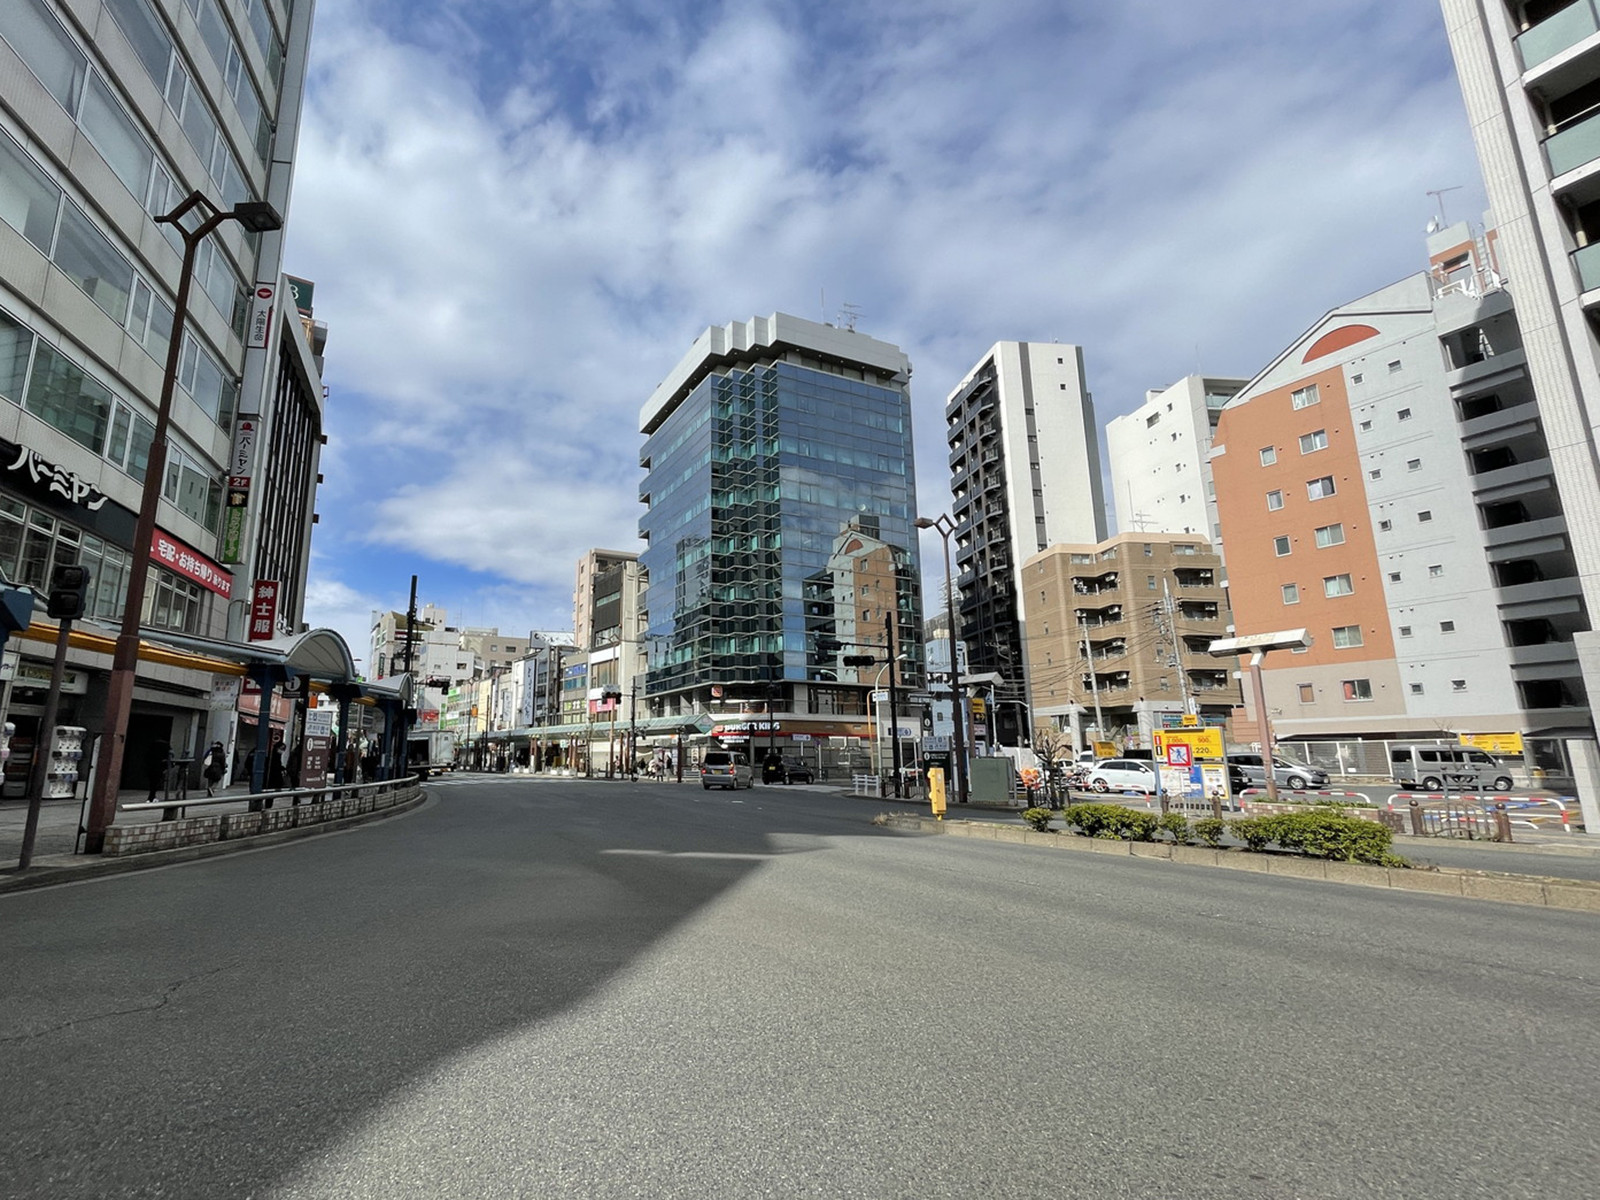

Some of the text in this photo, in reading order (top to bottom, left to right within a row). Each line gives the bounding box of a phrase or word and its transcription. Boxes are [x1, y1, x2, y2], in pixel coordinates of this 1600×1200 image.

[236, 436, 252, 475] バーミヤン
[7, 444, 108, 511] バーミヤン
[233, 478, 248, 486] 2F
[253, 586, 275, 633] 紳士服
